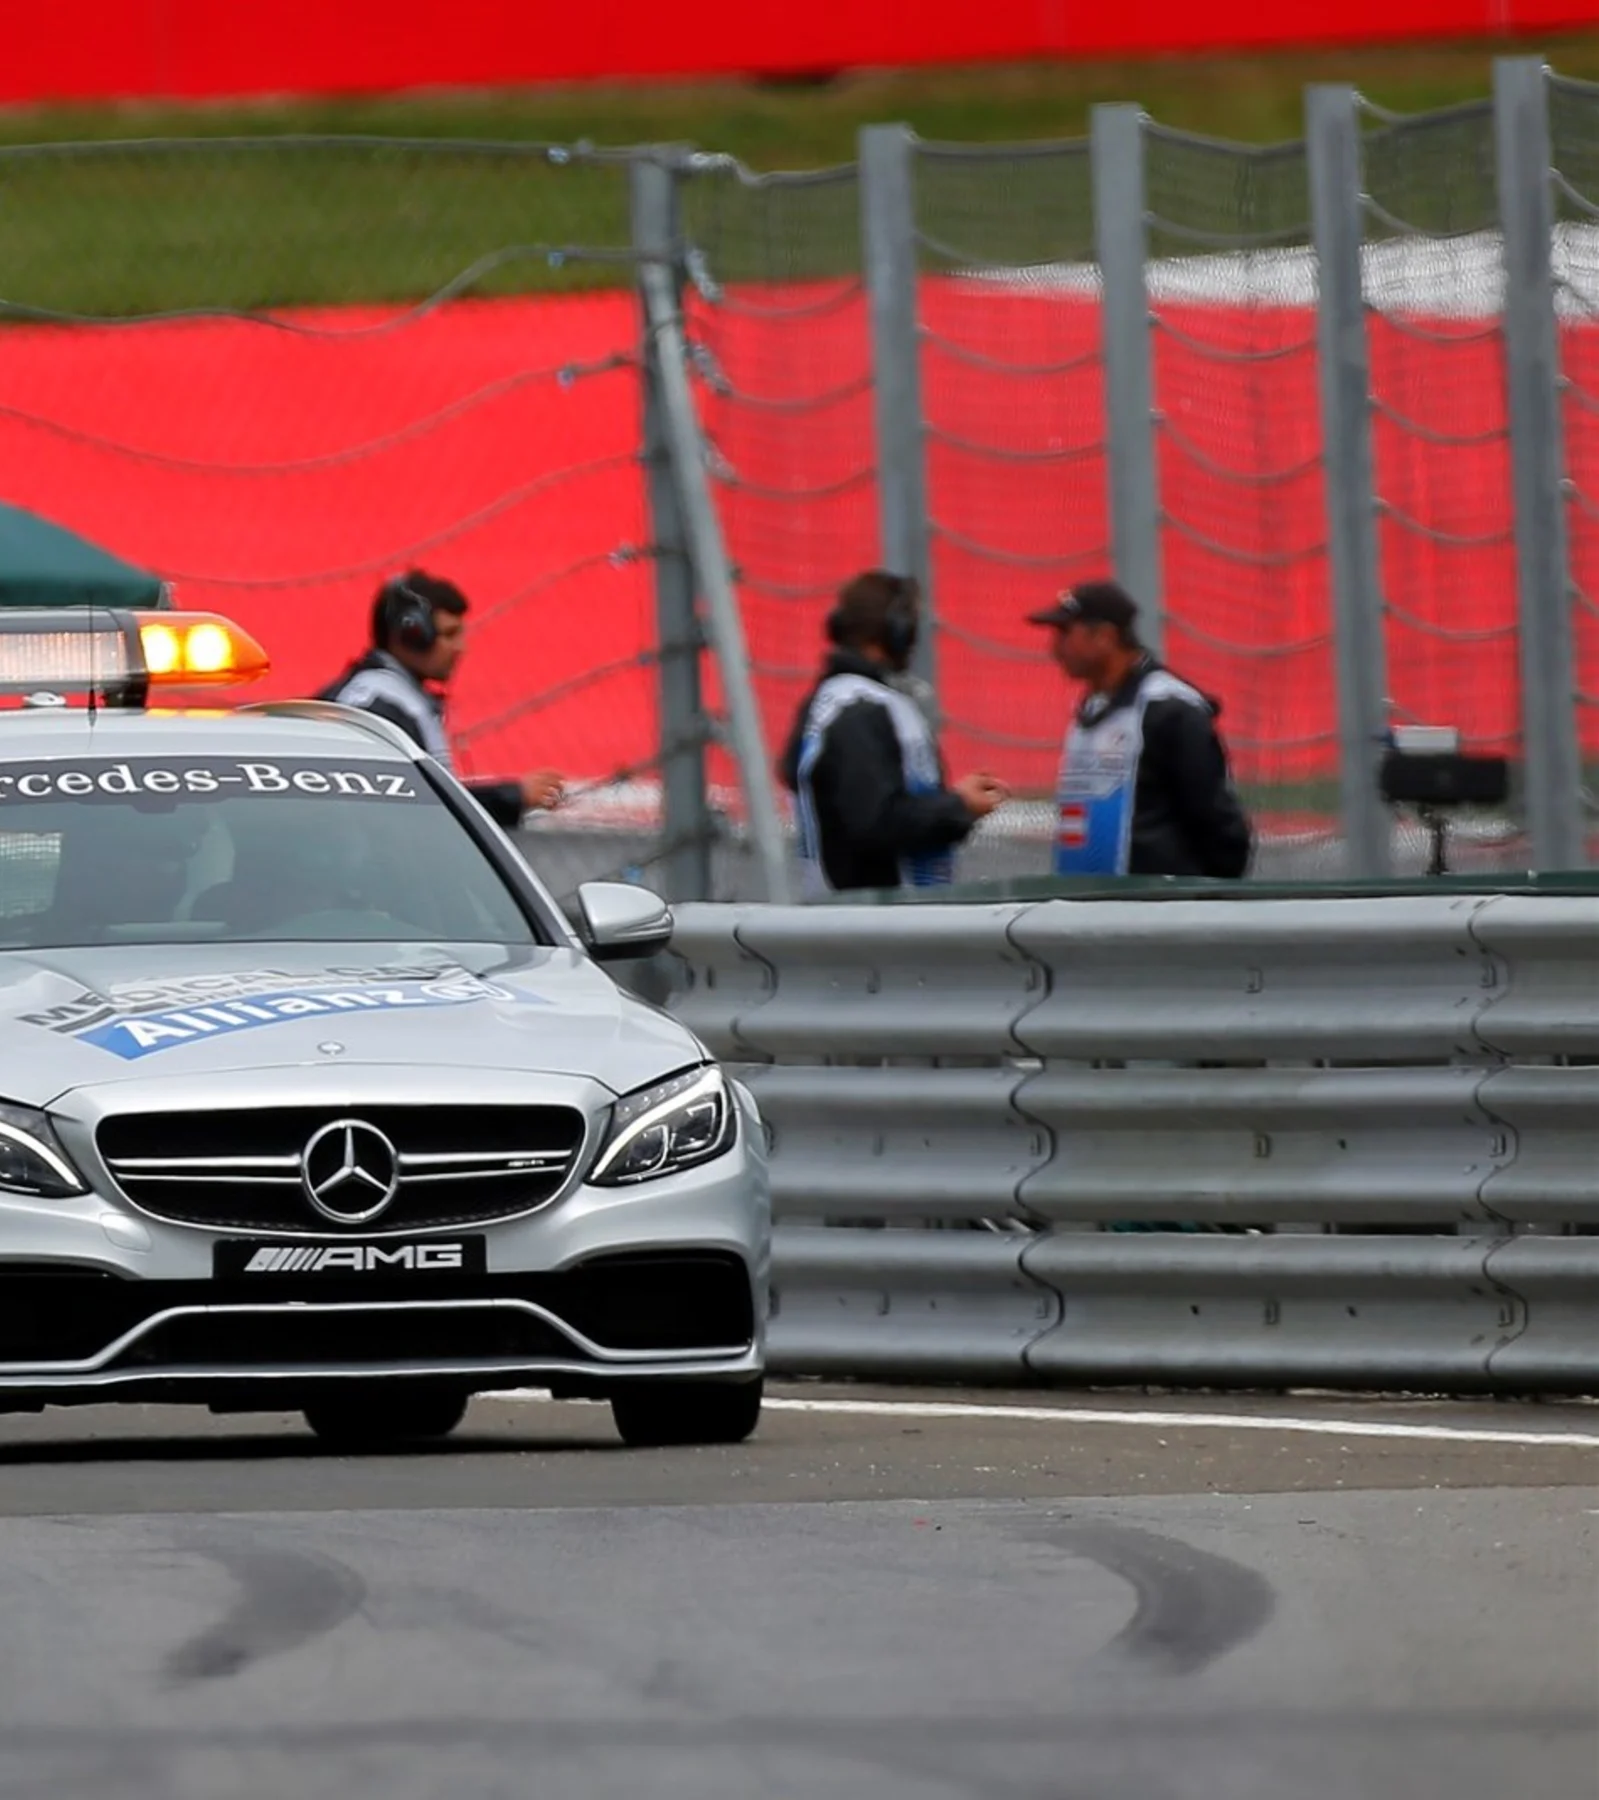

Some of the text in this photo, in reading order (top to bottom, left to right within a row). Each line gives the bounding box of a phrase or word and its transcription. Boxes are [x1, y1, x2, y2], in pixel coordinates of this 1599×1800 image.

[14, 967, 321, 1026] MEDICAL
[114, 989, 427, 1048] Allianz
[311, 1243, 462, 1271] AMG
